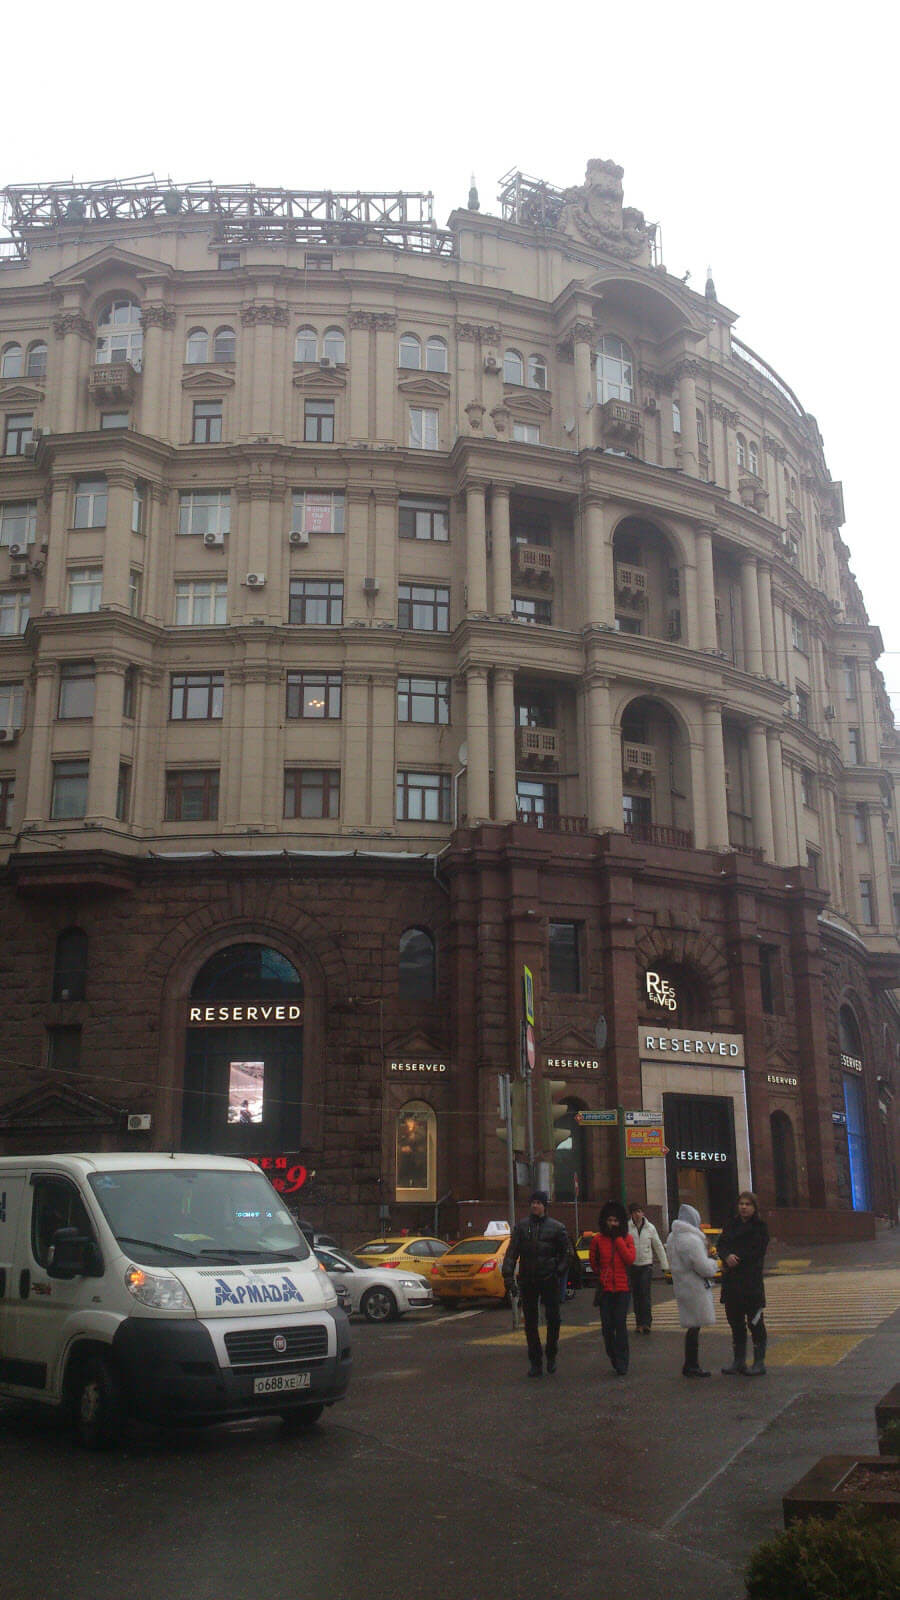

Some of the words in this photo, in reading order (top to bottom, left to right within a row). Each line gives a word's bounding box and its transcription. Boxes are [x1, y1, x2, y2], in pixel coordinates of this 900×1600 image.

[190, 1006, 301, 1021] RESERVED
[646, 1036, 739, 1056] RESERVED
[391, 1063, 447, 1072] RESERVED
[548, 1059, 600, 1069] RESERVED
